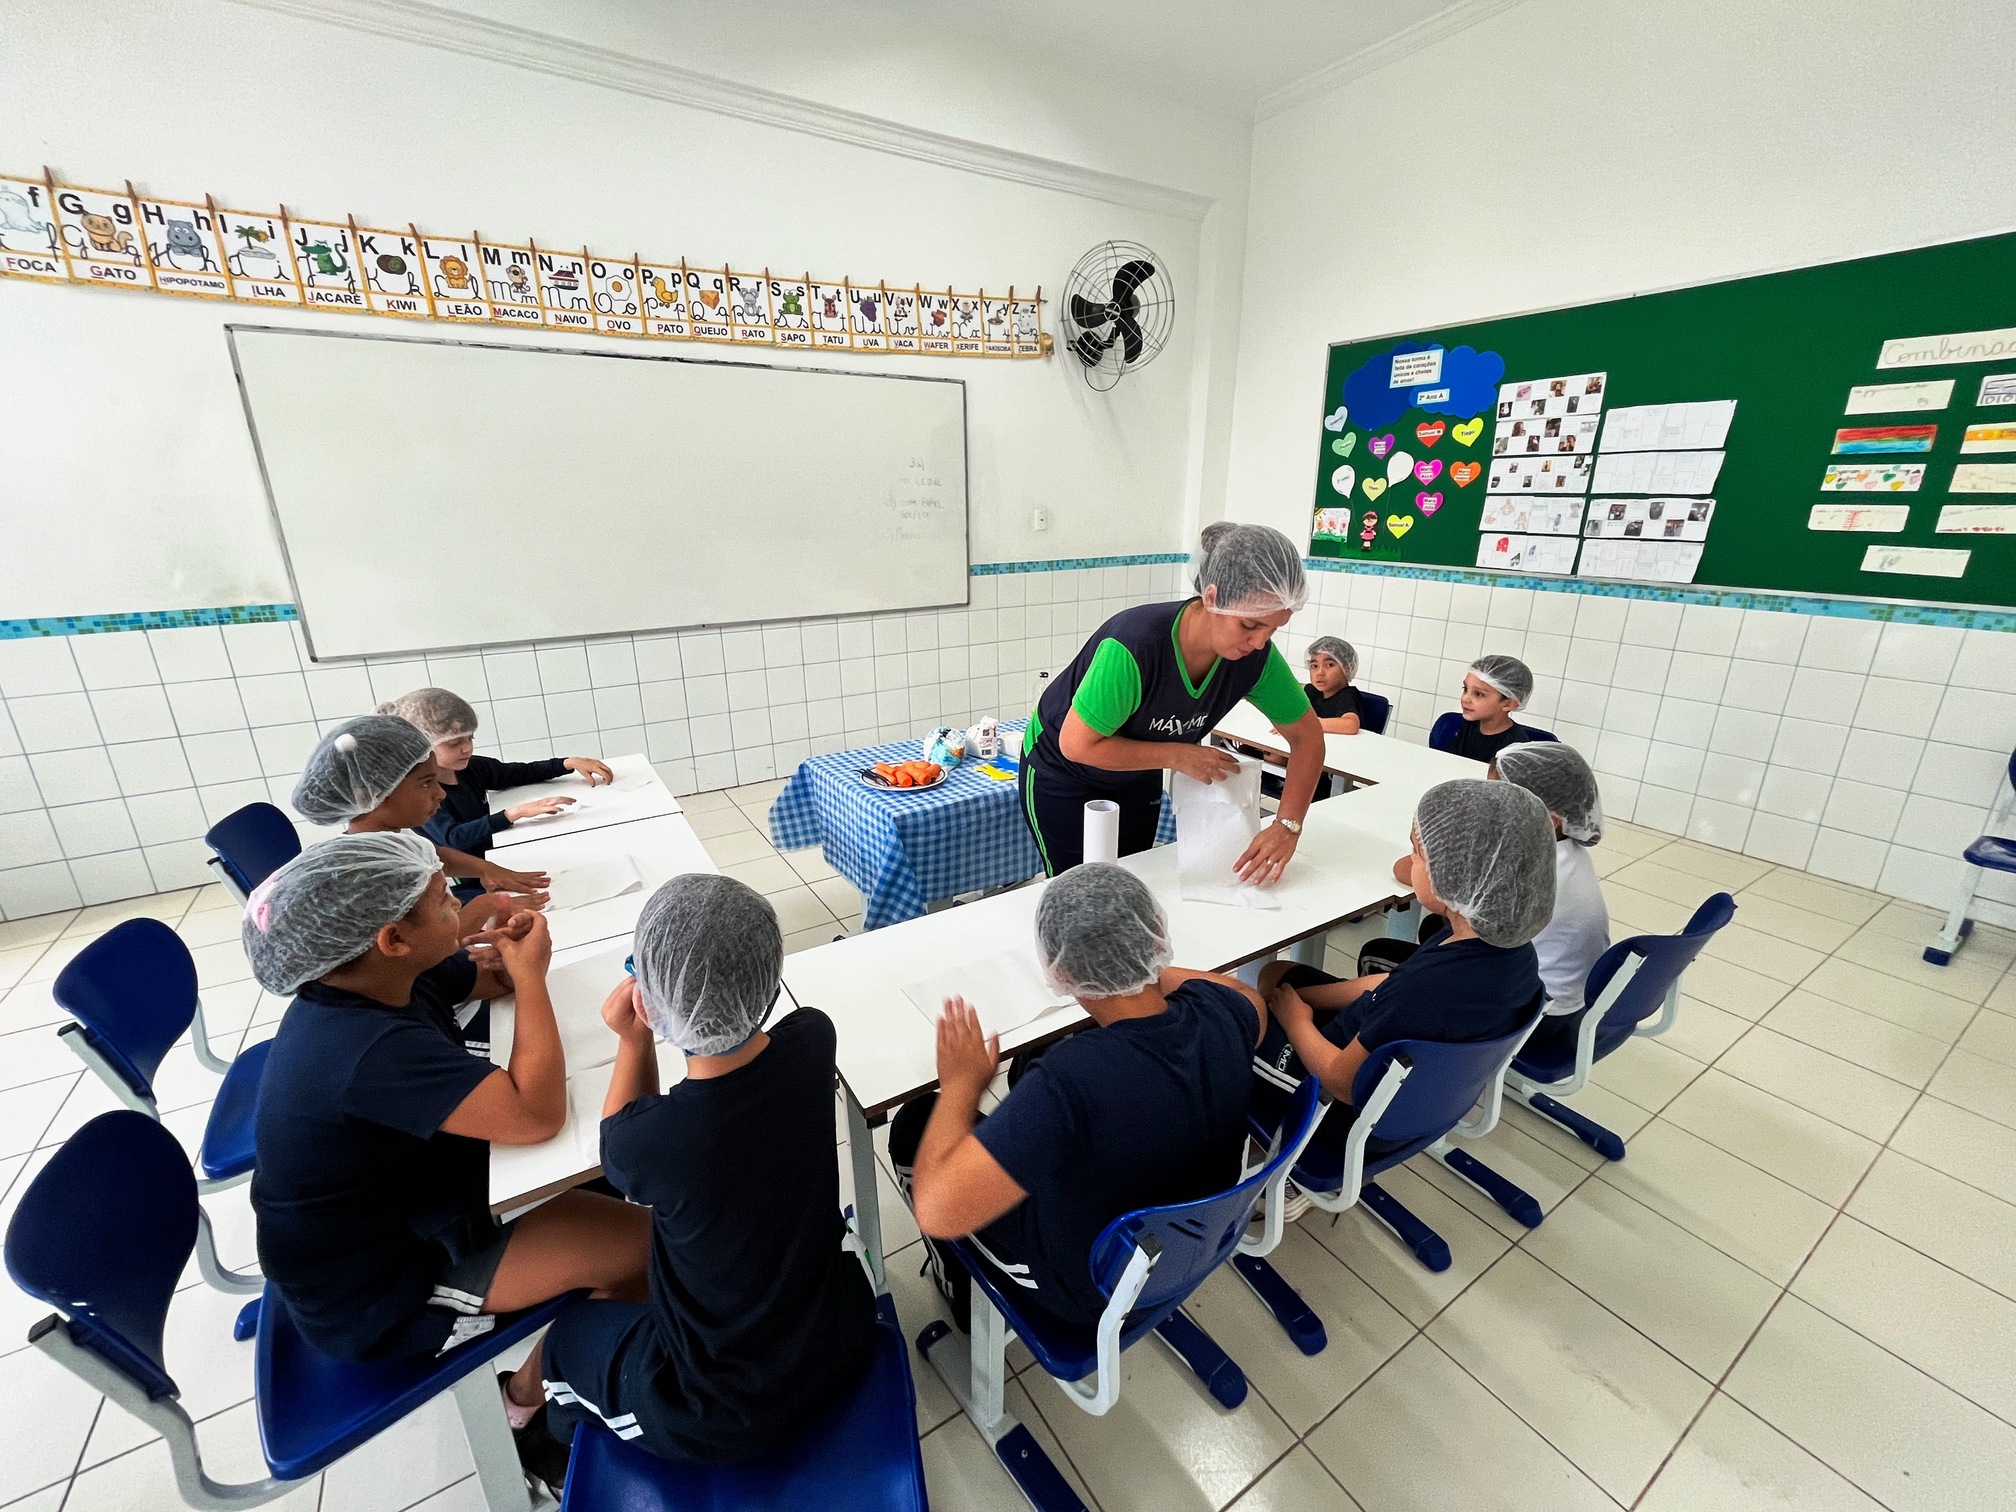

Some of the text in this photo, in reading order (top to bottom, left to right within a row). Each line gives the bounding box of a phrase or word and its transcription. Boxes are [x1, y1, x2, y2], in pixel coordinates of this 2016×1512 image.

[28, 186, 40, 208] f
[59, 194, 132, 225] G g
[141, 203, 212, 231] H h
[266, 220, 275, 240] i
[295, 228, 349, 253] J j
[359, 234, 416, 257] K k
[423, 241, 440, 260] L
[482, 246, 531, 266] M m
[6, 257, 57, 274] FOCA
[538, 254, 583, 275] N n
[591, 262, 635, 280] O o
[90, 265, 137, 283] GATO
[642, 268, 682, 288] P p
[686, 272, 723, 294] Q q
[730, 276, 762, 292] R r
[771, 282, 806, 297] S s
[252, 284, 286, 298] ILHA
[308, 290, 362, 305] JACARÉ
[811, 286, 842, 302] T t
[850, 290, 882, 304] U u
[386, 299, 417, 312] KIWI
[885, 292, 914, 308] V v
[920, 295, 949, 310] W w
[952, 298, 979, 310] X x
[448, 304, 482, 318] LEÃO
[493, 308, 539, 320] MACACO
[983, 301, 1010, 316] Y y
[1012, 302, 1037, 315] Z z
[555, 314, 587, 325] NAVIO
[607, 320, 631, 332] OVO
[658, 324, 684, 334] PATO
[694, 326, 728, 336] QUEIJO
[742, 329, 766, 340] RATO
[781, 332, 806, 343] SAPO
[822, 335, 844, 345] TATU
[863, 338, 880, 348] UVA
[894, 340, 914, 349] VACA
[923, 341, 949, 350] WAFER
[956, 342, 979, 351] XERIFE
